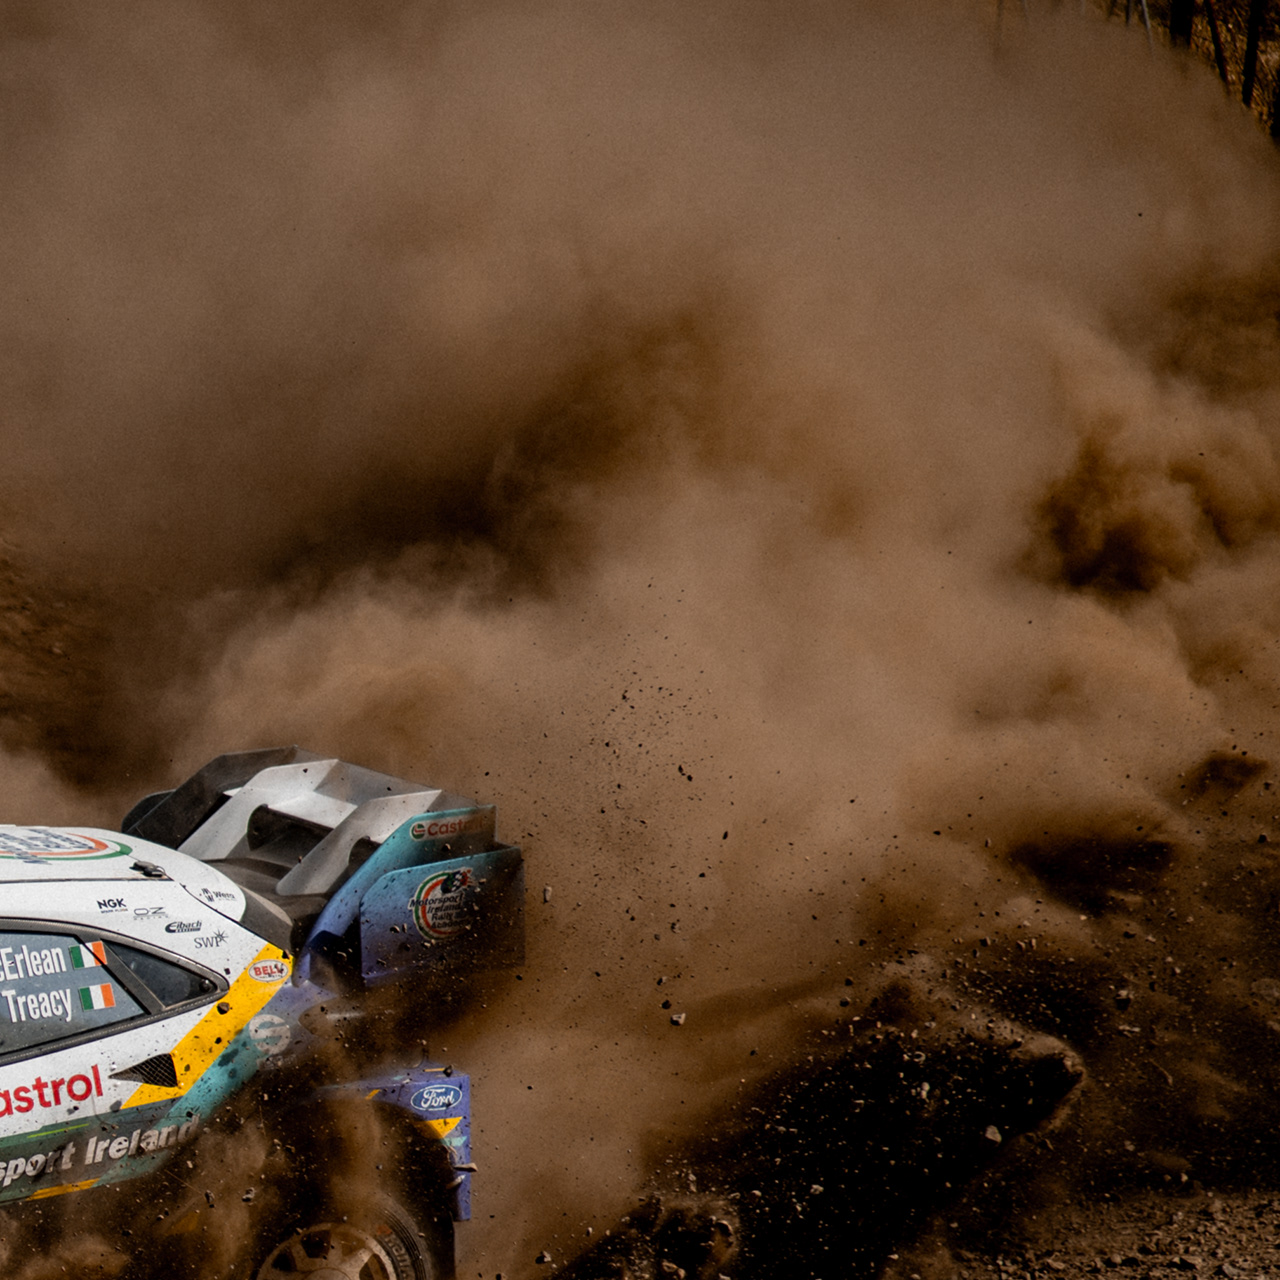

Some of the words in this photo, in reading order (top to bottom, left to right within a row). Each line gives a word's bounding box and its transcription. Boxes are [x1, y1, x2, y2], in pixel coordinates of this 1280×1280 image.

[96, 898, 127, 909] NGK
[410, 892, 464, 908] Motorsport
[133, 907, 166, 916] OZ
[165, 920, 202, 933] Eibach
[194, 936, 221, 949] SWP
[253, 964, 285, 977] BELL
[1, 988, 71, 1022] Treacy
[420, 1087, 457, 1109] Ford
[83, 1113, 200, 1166] Ireland
